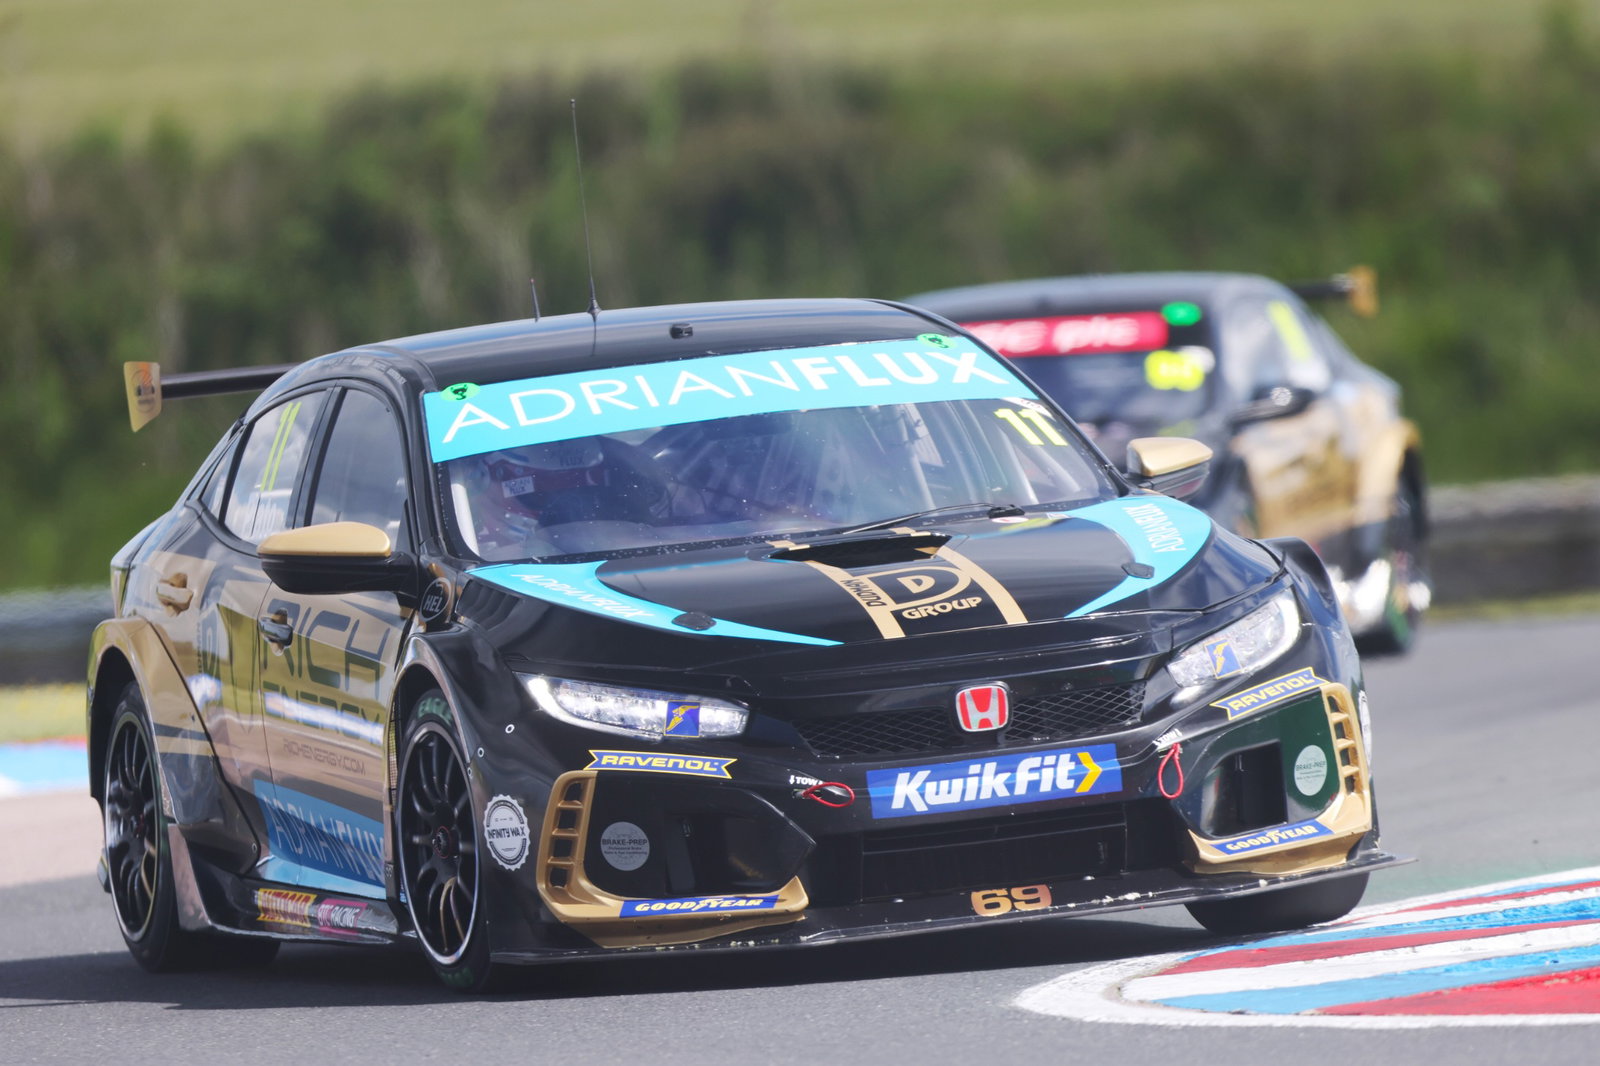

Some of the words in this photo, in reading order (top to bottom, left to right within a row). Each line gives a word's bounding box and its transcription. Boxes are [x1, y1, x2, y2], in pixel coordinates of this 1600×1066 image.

[442, 351, 1010, 444] ADRIANFLUX
[994, 407, 1069, 447] 11
[901, 596, 983, 620] GROUP
[262, 597, 391, 701] RICH
[1228, 674, 1316, 712] RAVENOL
[601, 754, 718, 772] RAVENOL
[601, 838, 648, 846] BRAKE-PREP
[1226, 824, 1320, 851] GOODYEAR
[635, 897, 764, 913] GOODYEAR
[970, 883, 1053, 918] 69
